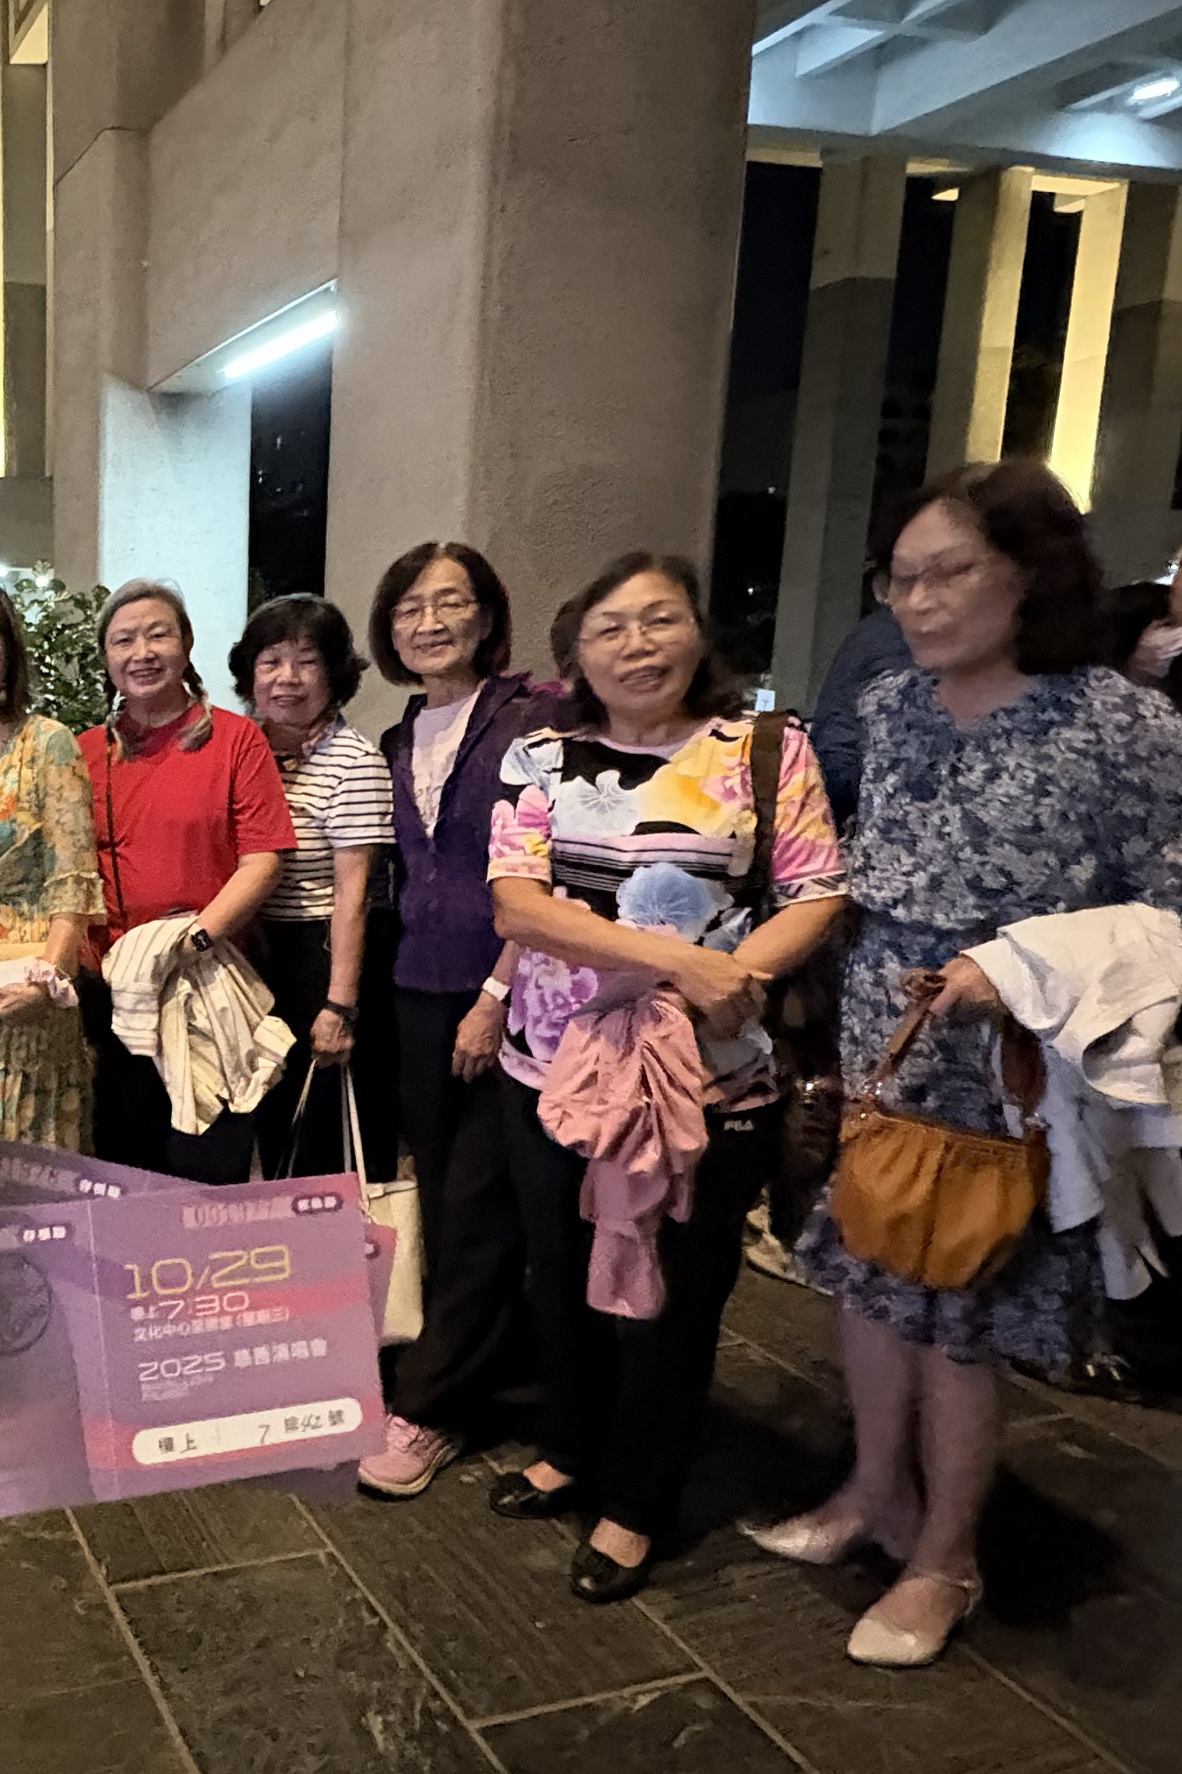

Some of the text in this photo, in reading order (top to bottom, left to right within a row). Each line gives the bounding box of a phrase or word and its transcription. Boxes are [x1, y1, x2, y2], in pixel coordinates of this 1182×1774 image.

[723, 1120, 754, 1132] FILA
[124, 1244, 293, 1300] 10/29
[138, 1351, 226, 1381] 2025
